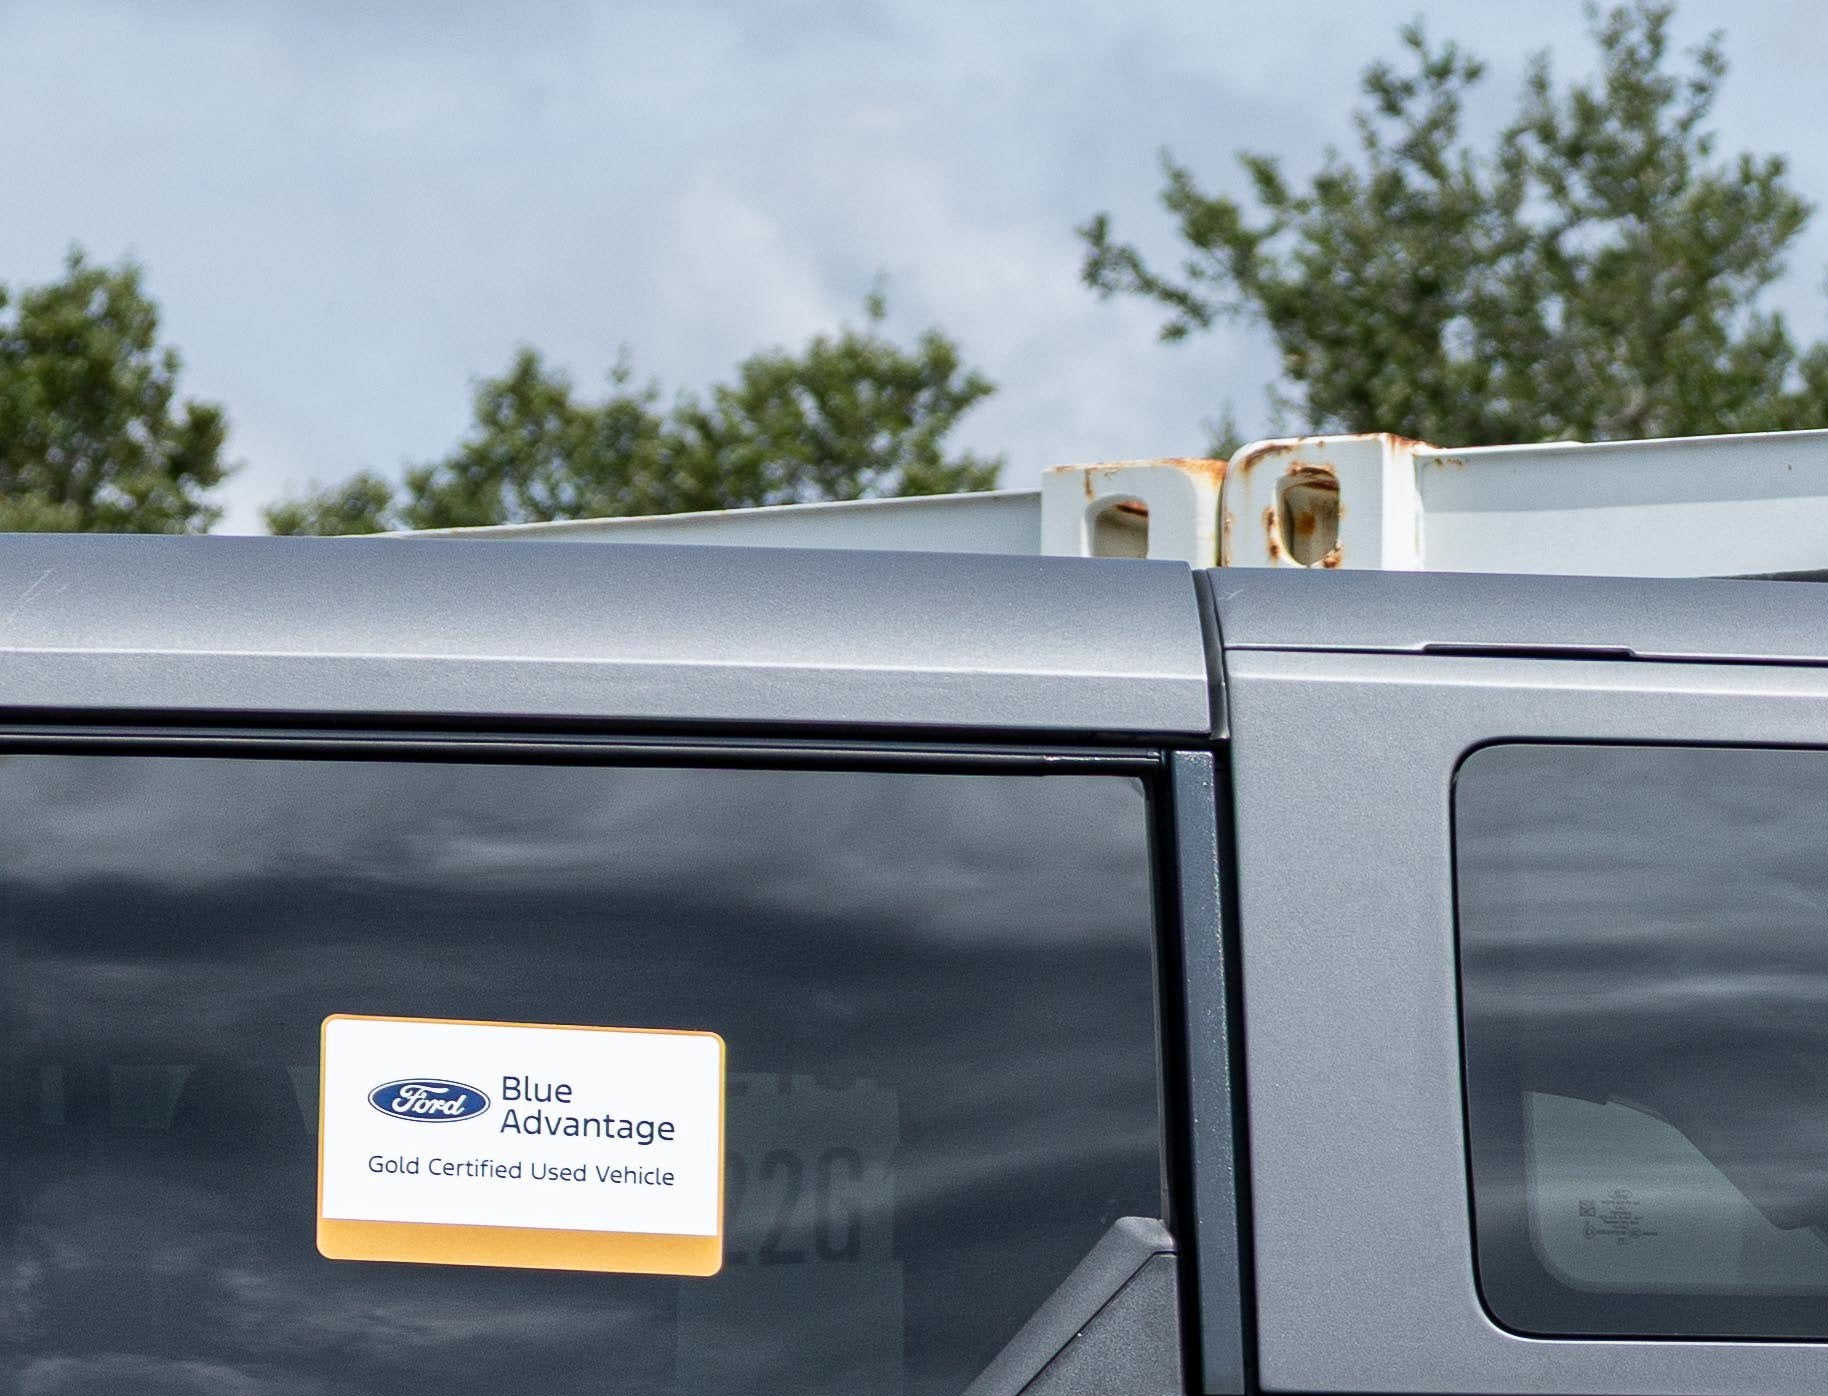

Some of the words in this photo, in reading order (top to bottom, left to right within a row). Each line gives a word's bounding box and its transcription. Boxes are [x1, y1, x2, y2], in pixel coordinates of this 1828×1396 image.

[392, 1084, 465, 1118] Ford
[502, 1076, 573, 1104] Blue
[500, 1109, 676, 1146] Advantage
[368, 1155, 420, 1176] Gold
[428, 1157, 522, 1180] Certified
[531, 1162, 586, 1183] Used
[595, 1165, 676, 1186] Vehicle
